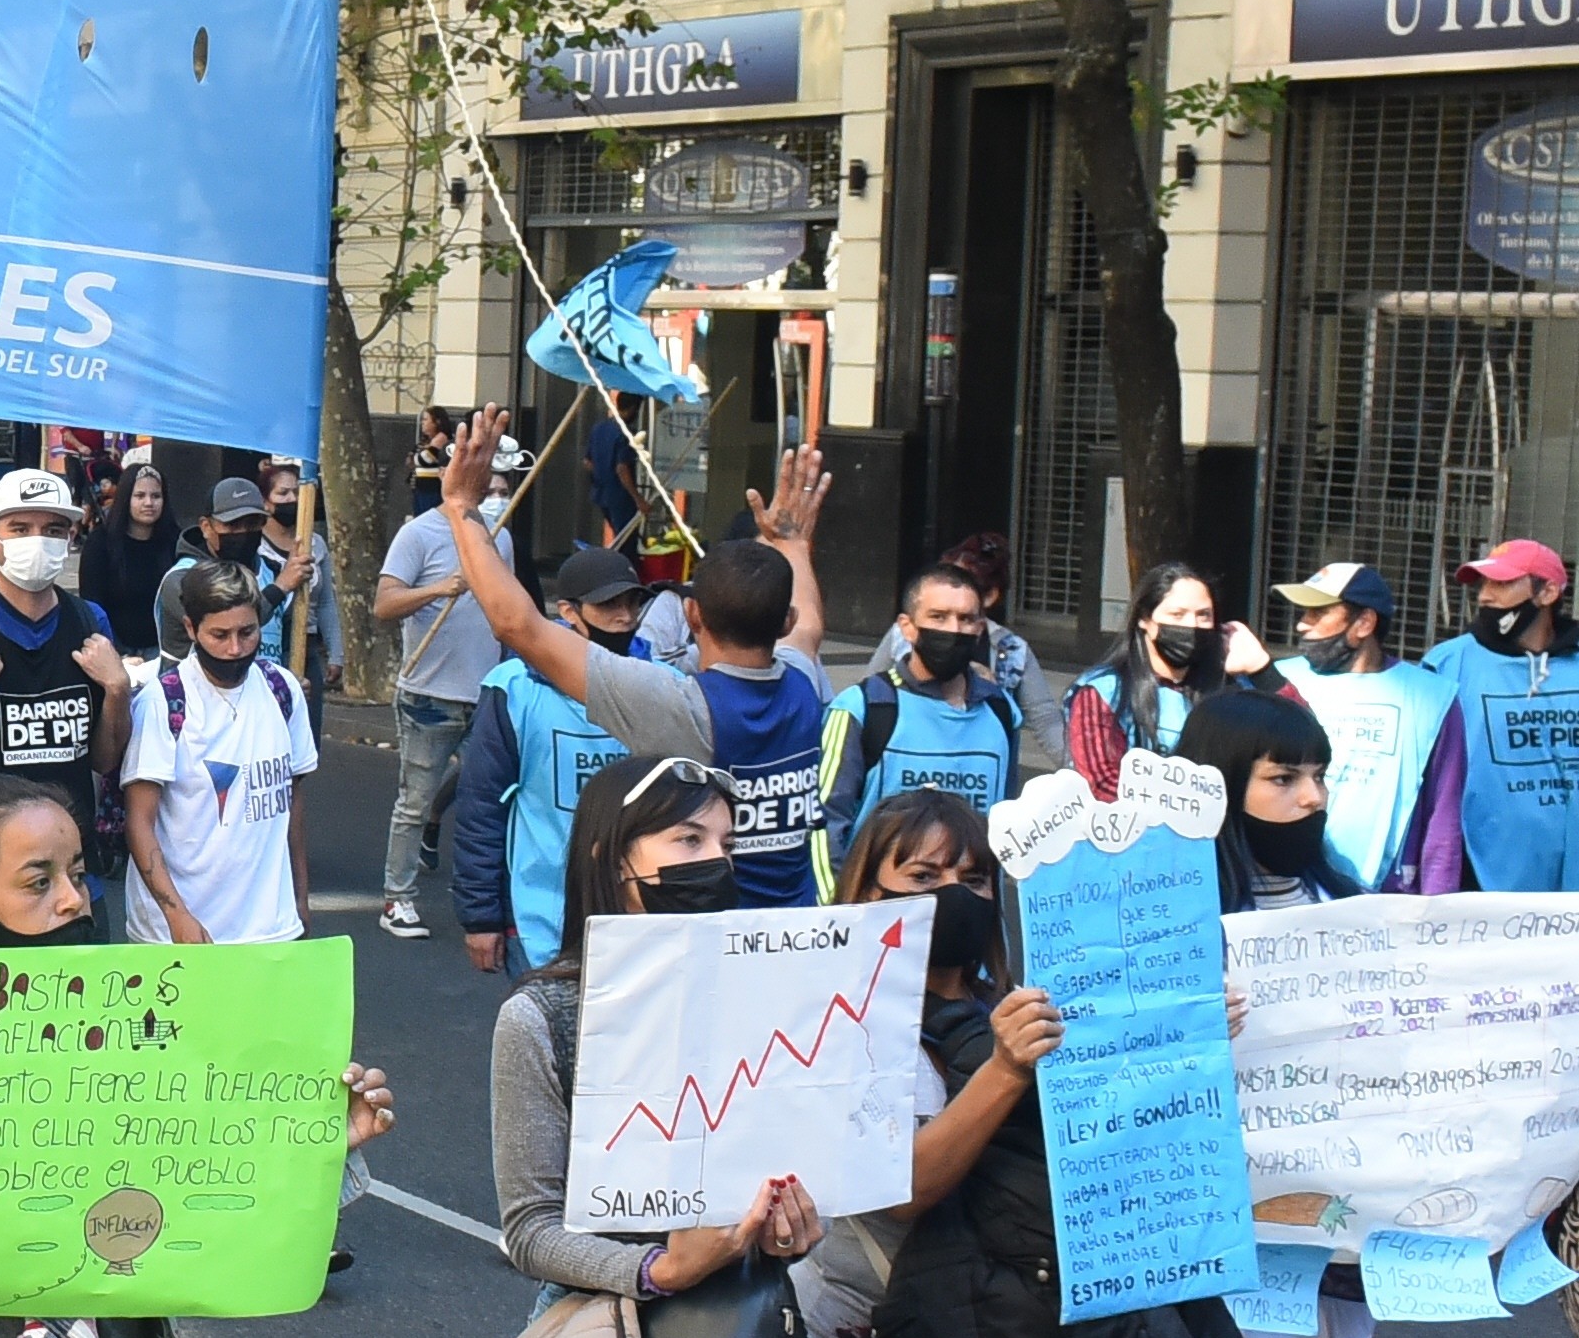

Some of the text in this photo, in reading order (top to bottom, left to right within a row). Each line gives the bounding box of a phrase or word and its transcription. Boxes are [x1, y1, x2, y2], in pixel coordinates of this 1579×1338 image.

[572, 36, 740, 102] UTHGRA
[45, 348, 110, 383] SUR
[6, 697, 90, 722] BARRIOS
[7, 716, 91, 747] DE PIE
[1355, 727, 1384, 744] PIE
[1508, 727, 1543, 749] DE
[5, 750, 74, 763] ORGANIZACIÓN
[900, 768, 989, 791] BARRIOS
[1132, 758, 1224, 800] EN 20 AÑOS
[1507, 780, 1536, 793] LOS
[733, 791, 824, 834] DE PIE
[1159, 793, 1201, 817] ALTA
[731, 832, 805, 851] RGANIZACIÓN
[1028, 891, 1073, 915] NAFTA
[1152, 903, 1172, 919] SE
[722, 919, 852, 957] INFLACIÓN
[1458, 919, 1489, 944] LA
[1399, 1017, 1435, 1033] 2021
[1043, 1041, 1118, 1069] SABEMOS
[154, 1069, 189, 1104] LA
[1047, 1072, 1109, 1094] SABEMOS
[1166, 1141, 1193, 1162] QUE
[1199, 1138, 1220, 1154] NO
[1200, 1163, 1221, 1178] EL
[1153, 1184, 1220, 1207] SOMOS EL
[1070, 1275, 1135, 1306] ESTADO
